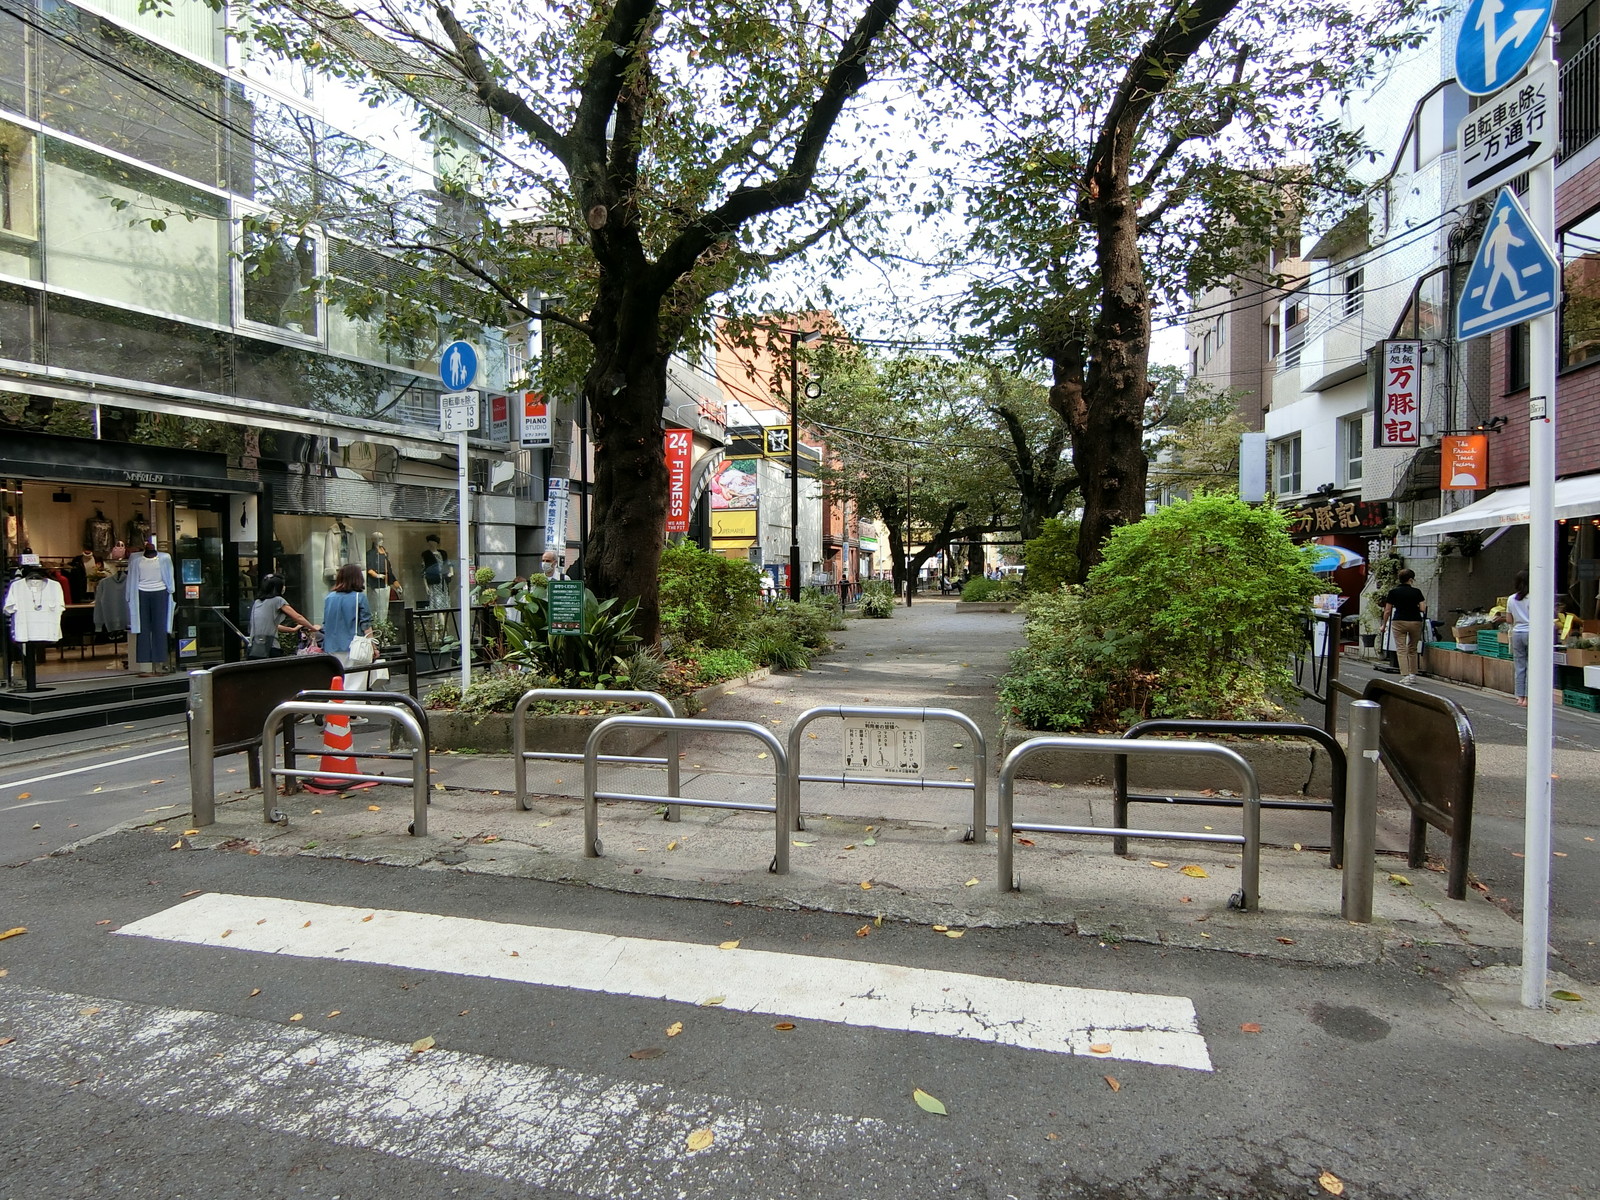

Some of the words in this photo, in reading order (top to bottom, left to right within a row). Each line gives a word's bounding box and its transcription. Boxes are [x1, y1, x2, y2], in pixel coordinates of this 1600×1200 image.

[1464, 82, 1546, 147] 自転車を除く
[1464, 104, 1546, 164] 一方通行
[1389, 344, 1400, 364] 酒処
[442, 395, 476, 407] 自転車を除く
[444, 410, 452, 418] 12
[466, 407, 474, 416] 13
[1384, 365, 1417, 443] 万豚記
[444, 421, 452, 430] 16
[466, 418, 474, 428] 18
[669, 433, 688, 449] 24
[1452, 461, 1476, 469] Factory
[672, 460, 684, 517] FITNESS
[547, 491, 558, 543] 松本整形外科
[1297, 501, 1360, 533] 万豚記
